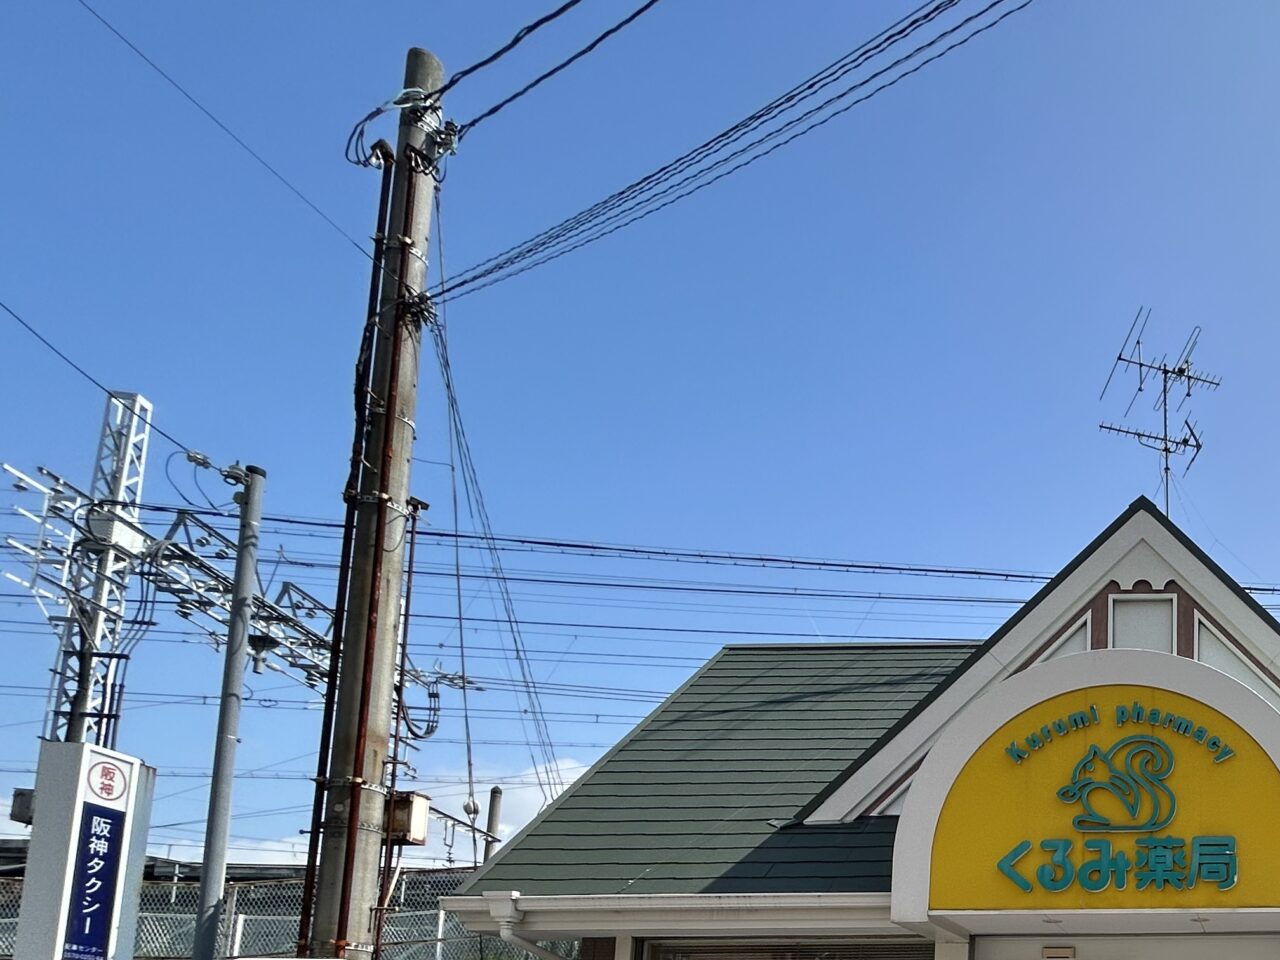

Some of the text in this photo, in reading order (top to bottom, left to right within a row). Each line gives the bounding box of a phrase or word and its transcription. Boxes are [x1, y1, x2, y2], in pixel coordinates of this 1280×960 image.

[1004, 701, 1236, 766] Kurumi pharmacy
[98, 765, 117, 797] 阪神
[82, 815, 113, 935] 阪神タクシー
[997, 834, 1239, 893] くるみ薬局
